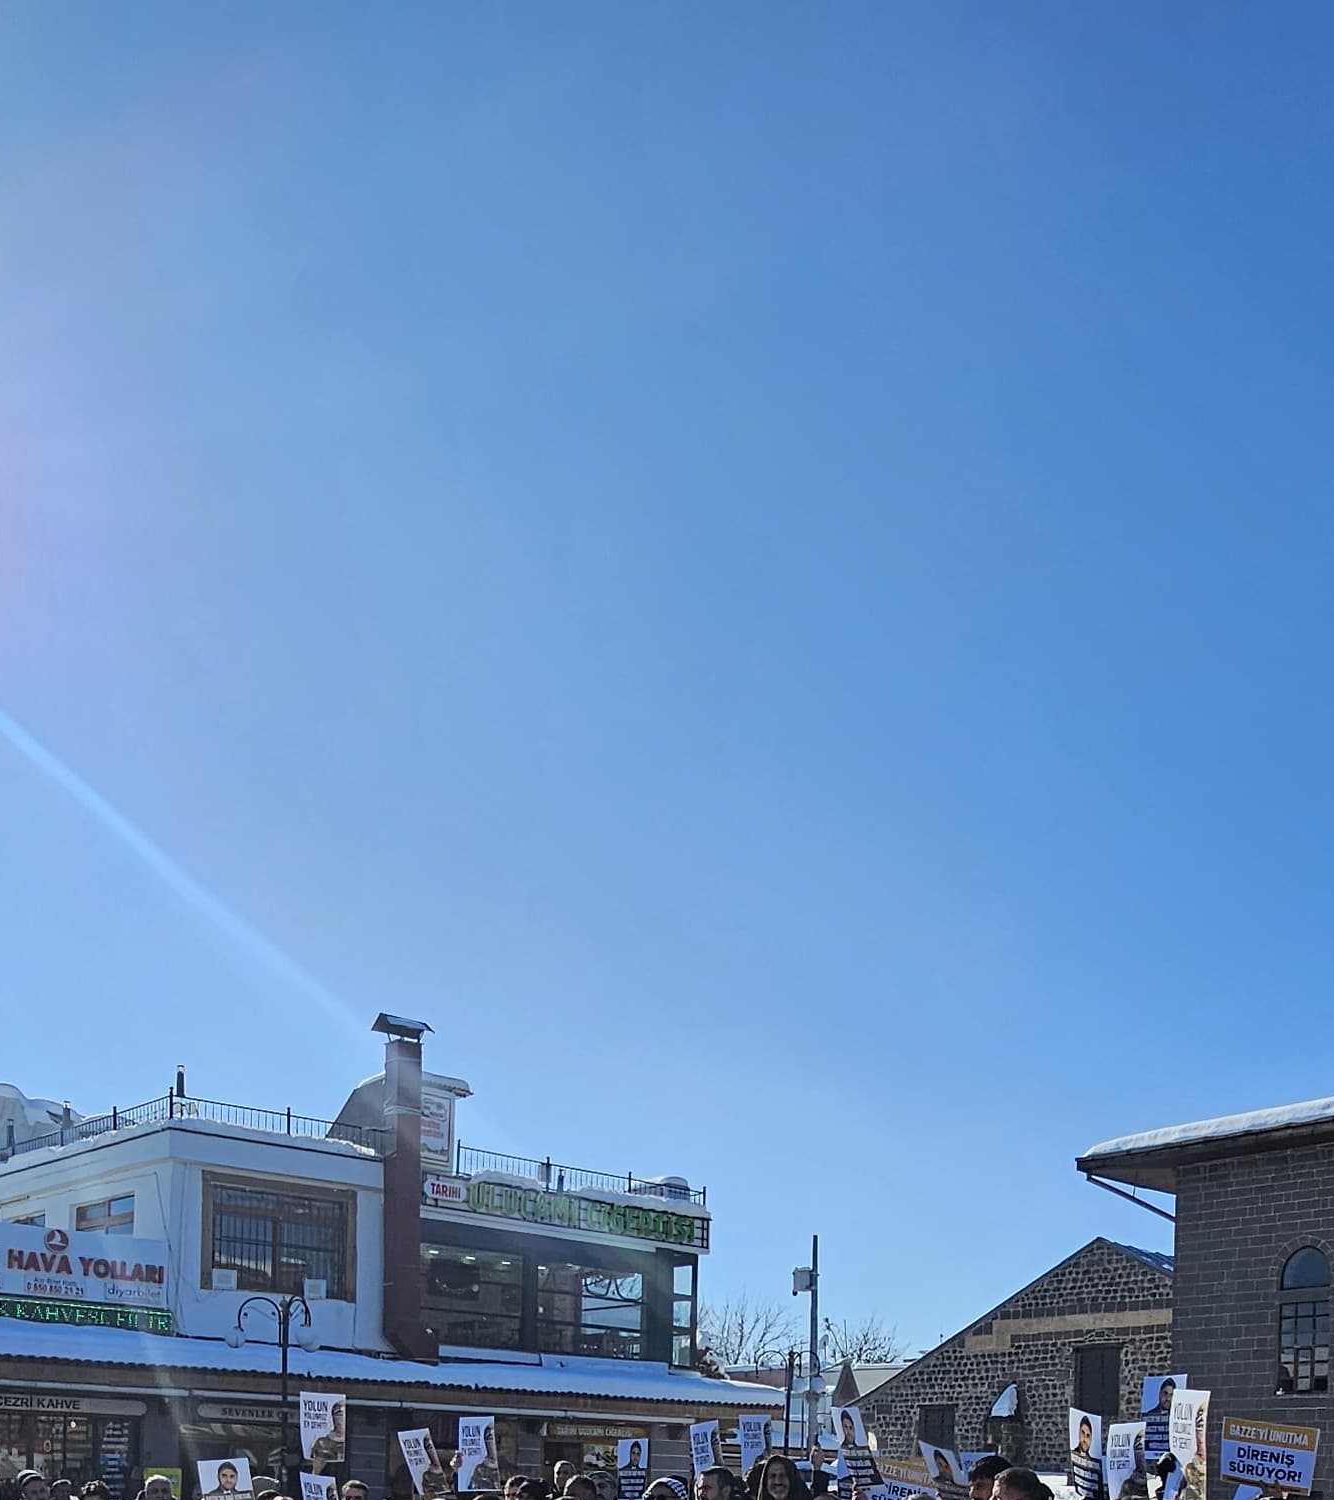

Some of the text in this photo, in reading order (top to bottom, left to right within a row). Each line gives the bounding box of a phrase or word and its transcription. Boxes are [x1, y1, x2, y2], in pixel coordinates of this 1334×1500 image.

[8, 1249, 72, 1275] HAVA
[79, 1256, 165, 1285] YOLLARI
[36, 1397, 81, 1410] KAHVE
[220, 1406, 274, 1419] SEVENLER
[303, 1399, 328, 1412] YOLUN
[1269, 1428, 1309, 1446] UNUTMA
[1237, 1445, 1295, 1468] DİRENİŞ
[1228, 1460, 1302, 1483] SÜRÜYOR!
